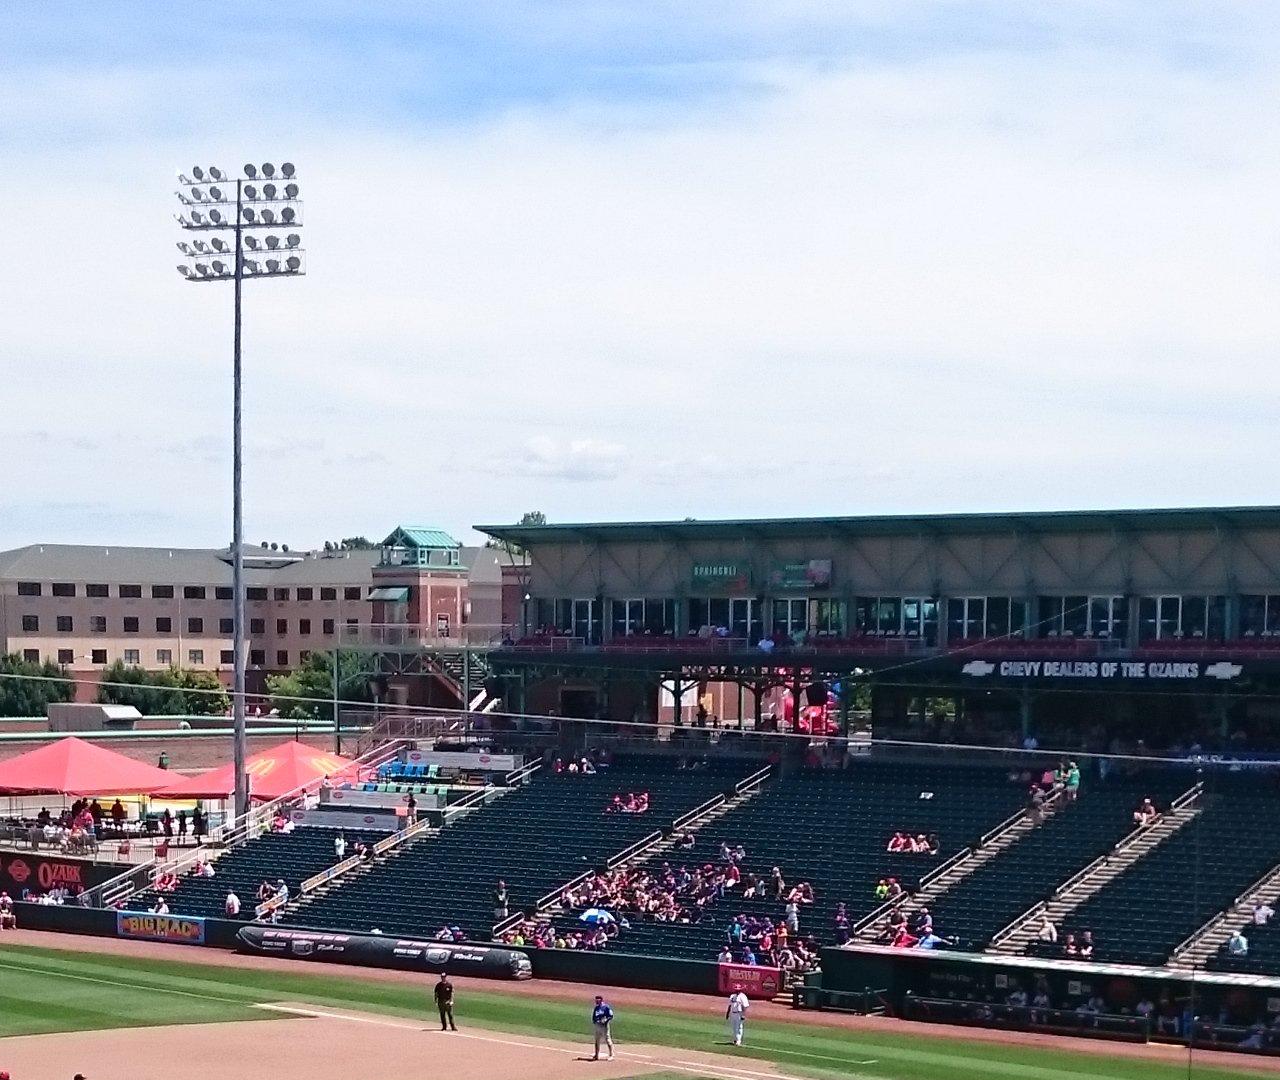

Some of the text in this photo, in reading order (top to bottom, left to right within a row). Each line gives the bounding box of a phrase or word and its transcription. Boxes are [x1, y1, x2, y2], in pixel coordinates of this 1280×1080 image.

[1000, 661, 1199, 678] CHEVY DEALERS OF THE OZARKS
[38, 862, 81, 888] OZARK
[129, 917, 155, 932] BIG
